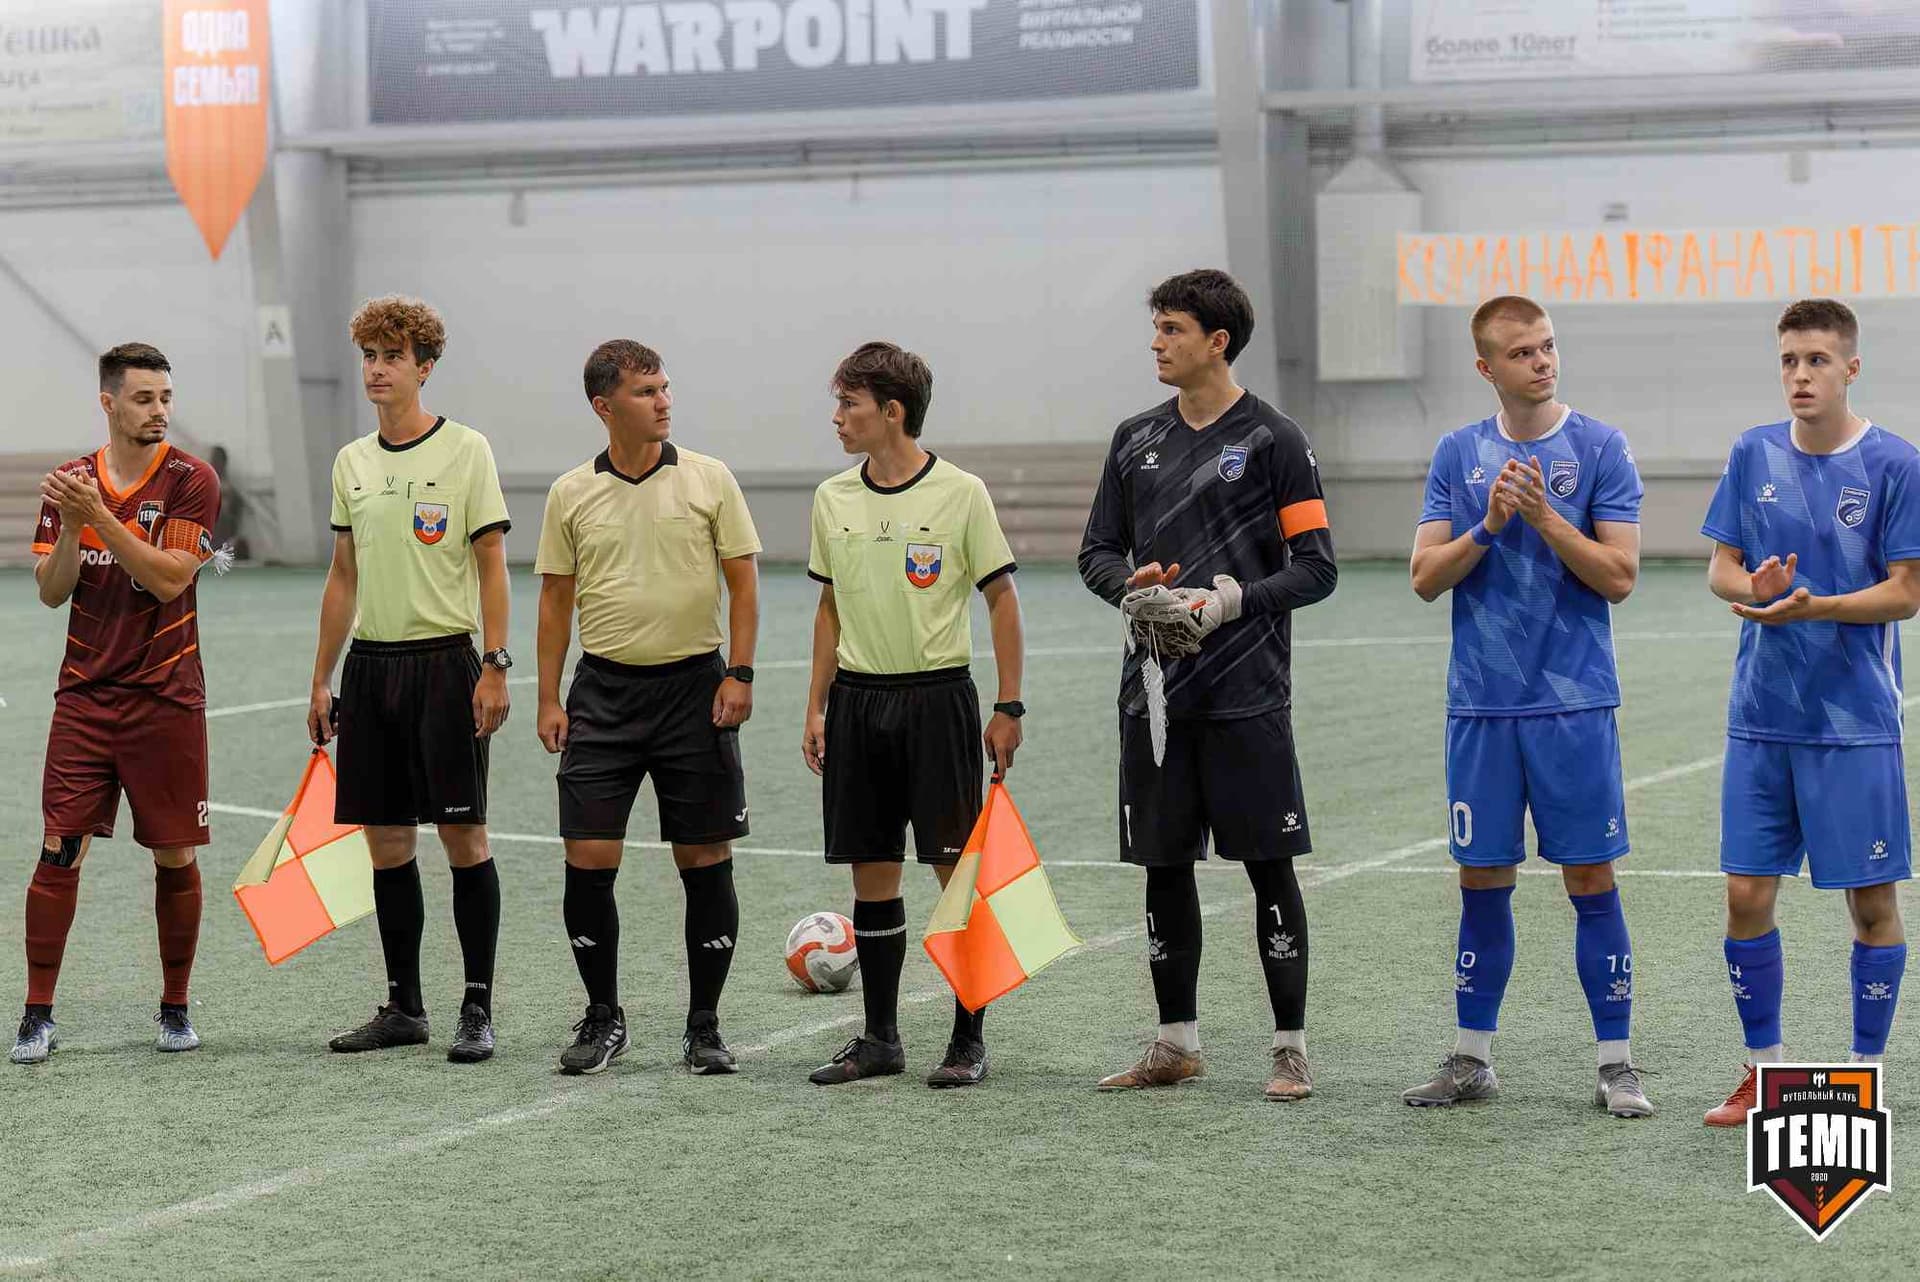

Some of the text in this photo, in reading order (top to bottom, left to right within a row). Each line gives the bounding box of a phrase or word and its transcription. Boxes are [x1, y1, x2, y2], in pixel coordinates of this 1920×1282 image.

[0, 25, 102, 56] ешка
[1269, 904, 1282, 926] 1
[1268, 950, 1298, 960] KELME
[1862, 993, 1893, 1001] KELME
